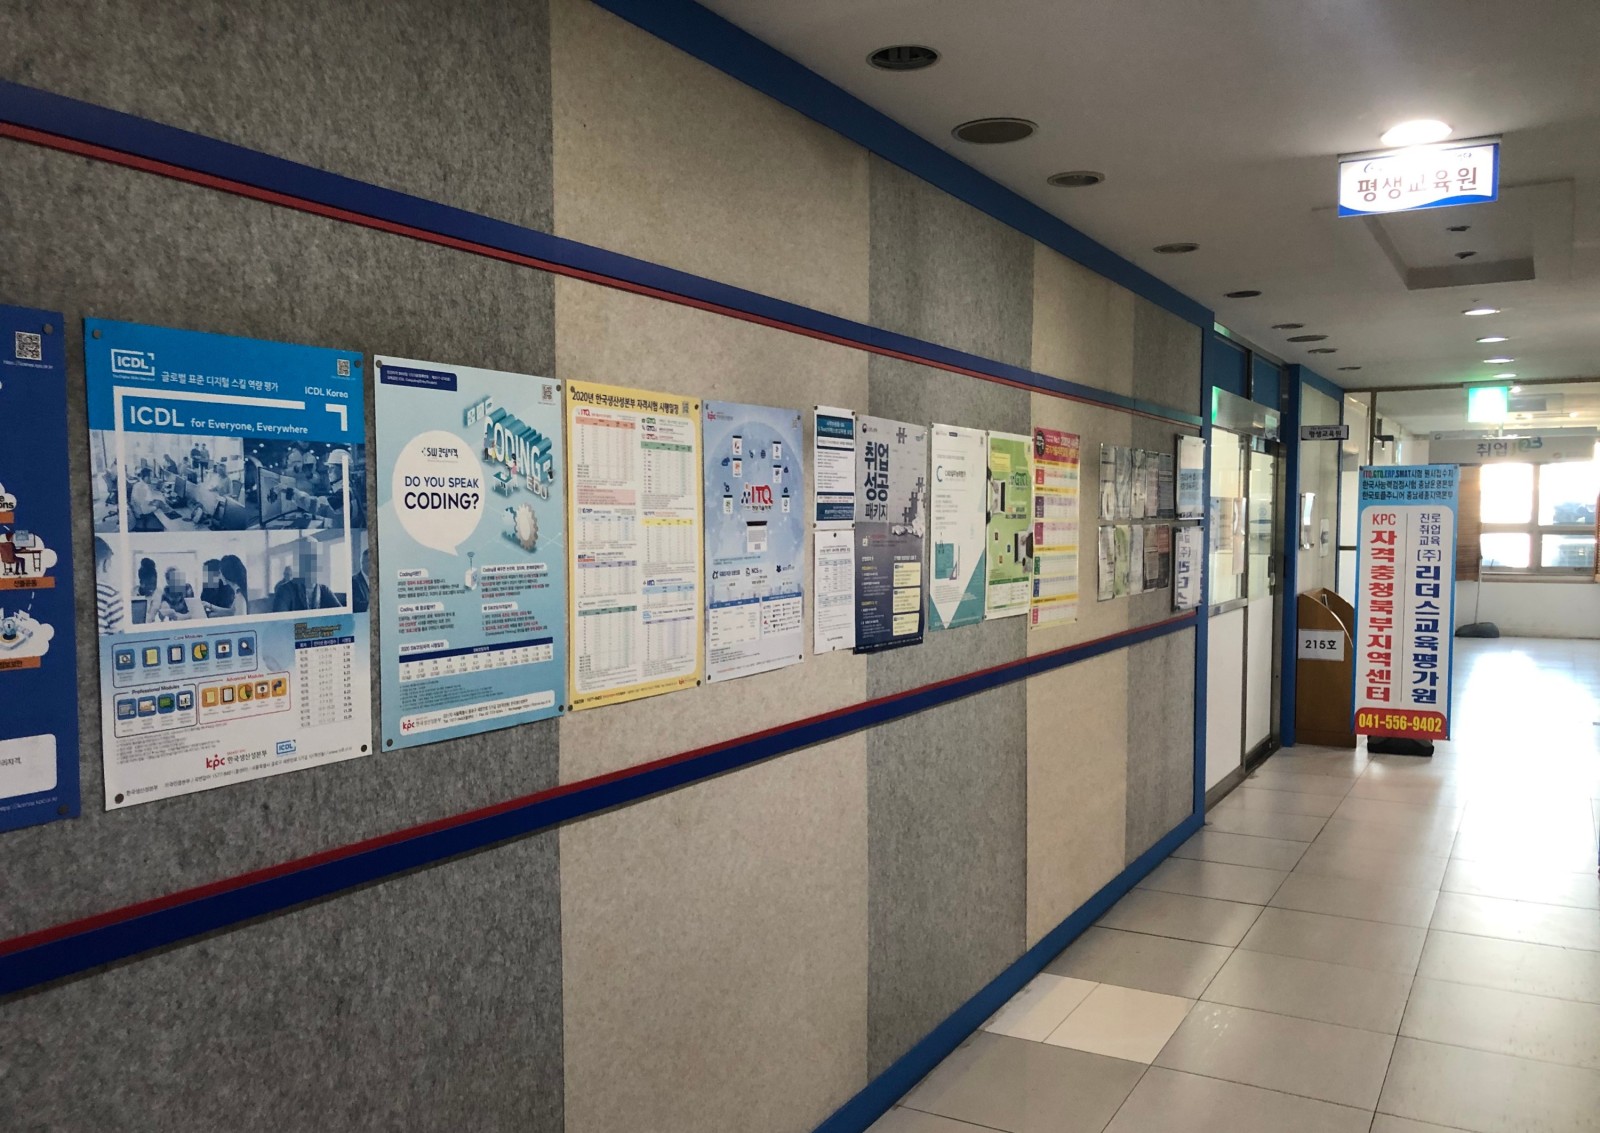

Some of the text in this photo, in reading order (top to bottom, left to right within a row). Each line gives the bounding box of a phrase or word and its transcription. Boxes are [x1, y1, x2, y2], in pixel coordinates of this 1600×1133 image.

[1357, 167, 1477, 202] 평생교육원
[117, 356, 149, 369] ICDL
[161, 371, 187, 385] 글로벌
[188, 374, 204, 386] 표준
[206, 376, 229, 388] 디지털
[231, 379, 246, 389] 스킬
[264, 381, 278, 392] 평가
[304, 386, 348, 398] ICDL Korea
[572, 391, 594, 404] 2020년
[595, 393, 635, 409] 한국생산성본부
[637, 399, 658, 412] 자격시험
[130, 405, 308, 435] ICDL for Everyone, Everywhere
[864, 441, 889, 472] 취업
[1476, 442, 1507, 457] 취업
[405, 476, 479, 489] DO YOU SPEAK
[526, 476, 548, 500] EDU
[864, 472, 889, 502] 성공
[1362, 480, 1417, 490] 한국사능력검정시험
[404, 492, 480, 510] CODING?
[751, 485, 773, 504] ITQ
[865, 503, 888, 521] 패키지
[1372, 513, 1396, 526] KPC
[1420, 513, 1441, 523] 진로
[1420, 524, 1441, 535] 취업
[1420, 535, 1441, 546] 교육
[1365, 529, 1397, 703] 자격충청북부지역센터
[1411, 565, 1441, 704] 리더스교육평가원
[1305, 639, 1337, 650] 215호
[402, 719, 415, 731] kpc
[1358, 713, 1442, 733] 041-556-9402
[206, 750, 268, 770] kpc 한국생산성본부
